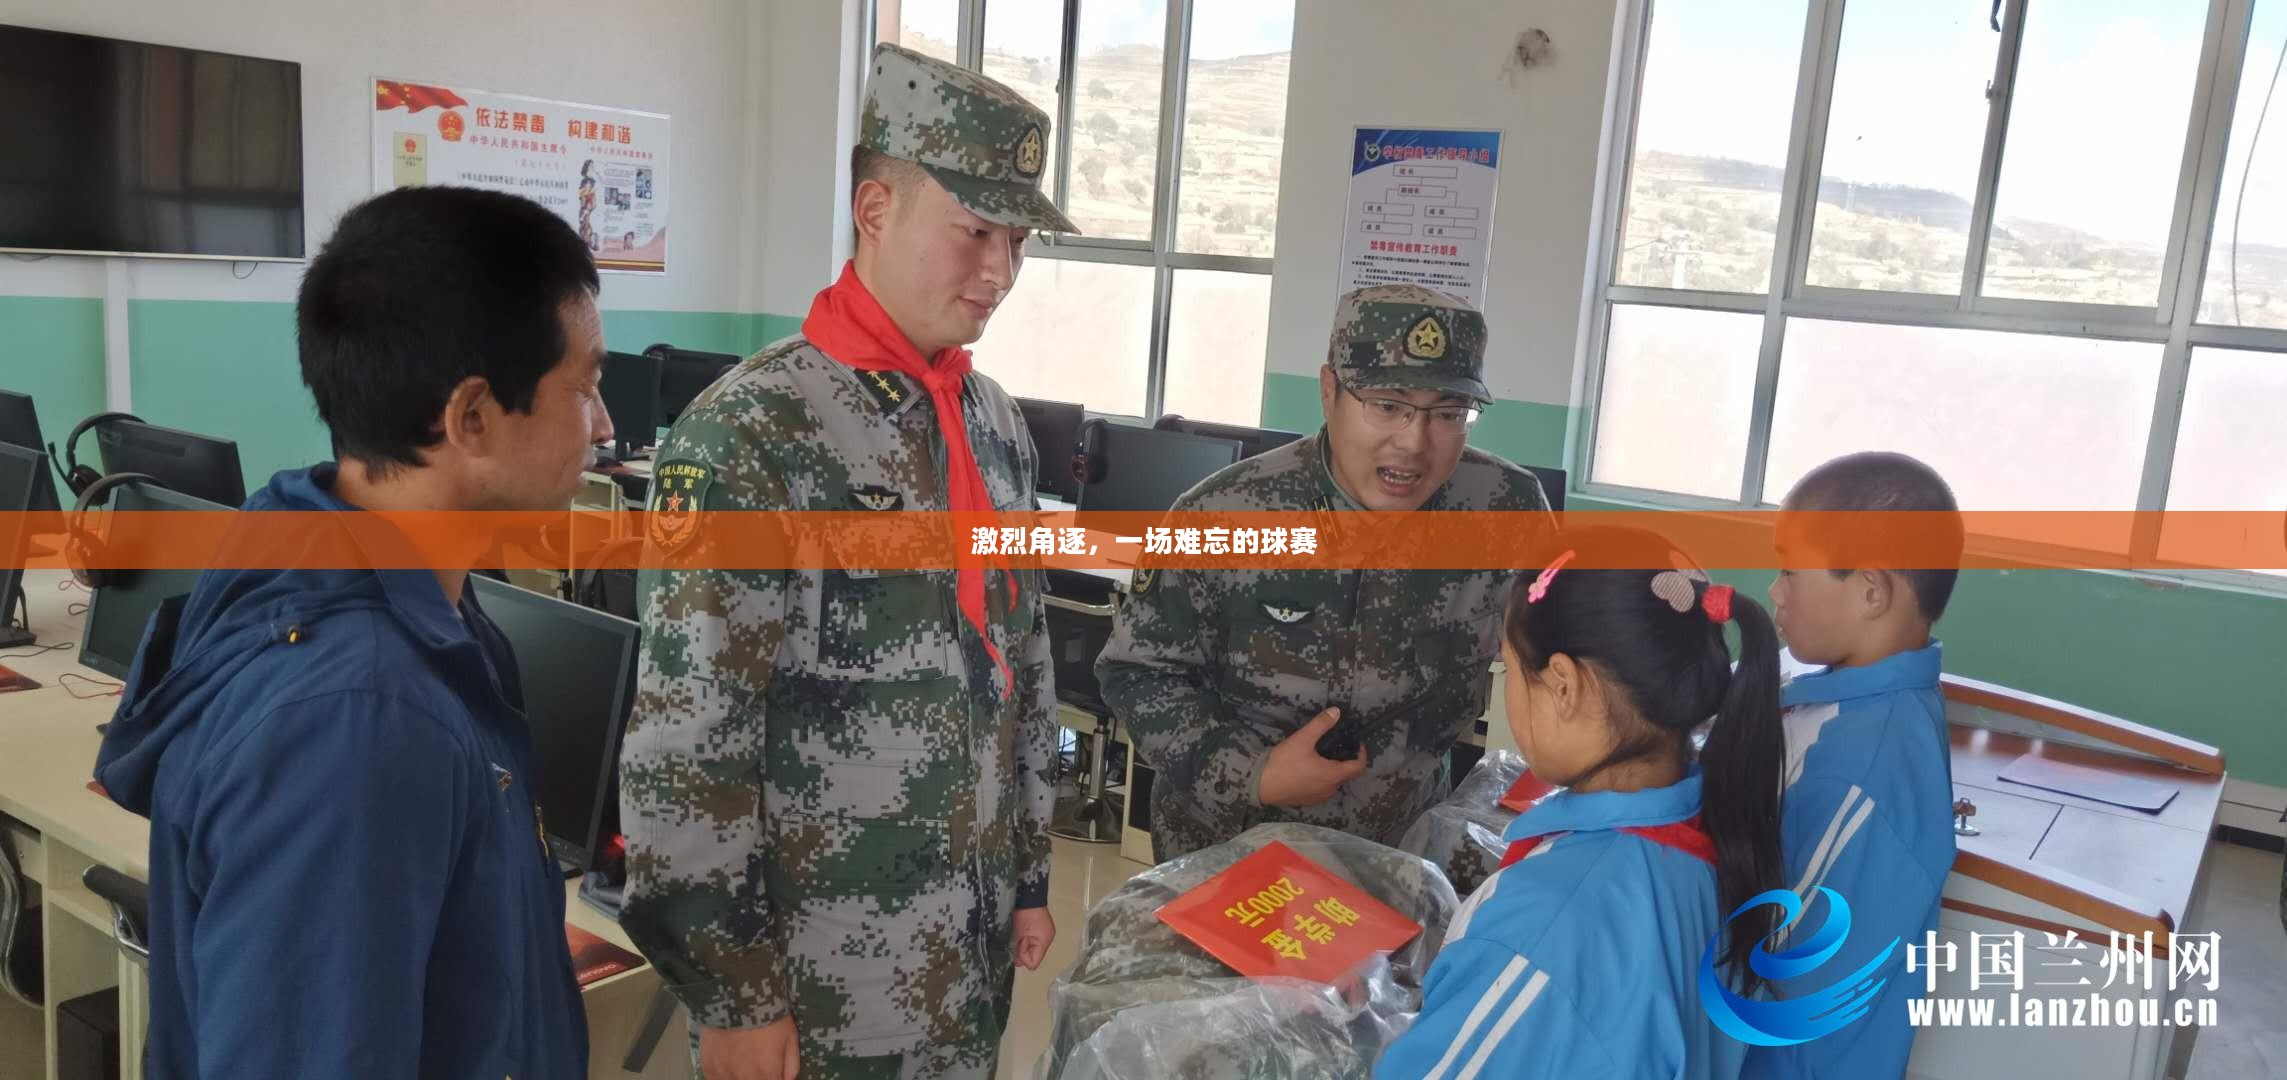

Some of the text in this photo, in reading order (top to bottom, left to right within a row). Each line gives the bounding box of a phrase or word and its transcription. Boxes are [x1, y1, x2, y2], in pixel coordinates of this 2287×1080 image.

[567, 119, 632, 144] 构建和谐
[1224, 876, 1305, 929] 2000元
[1260, 896, 1361, 961] 助学金
